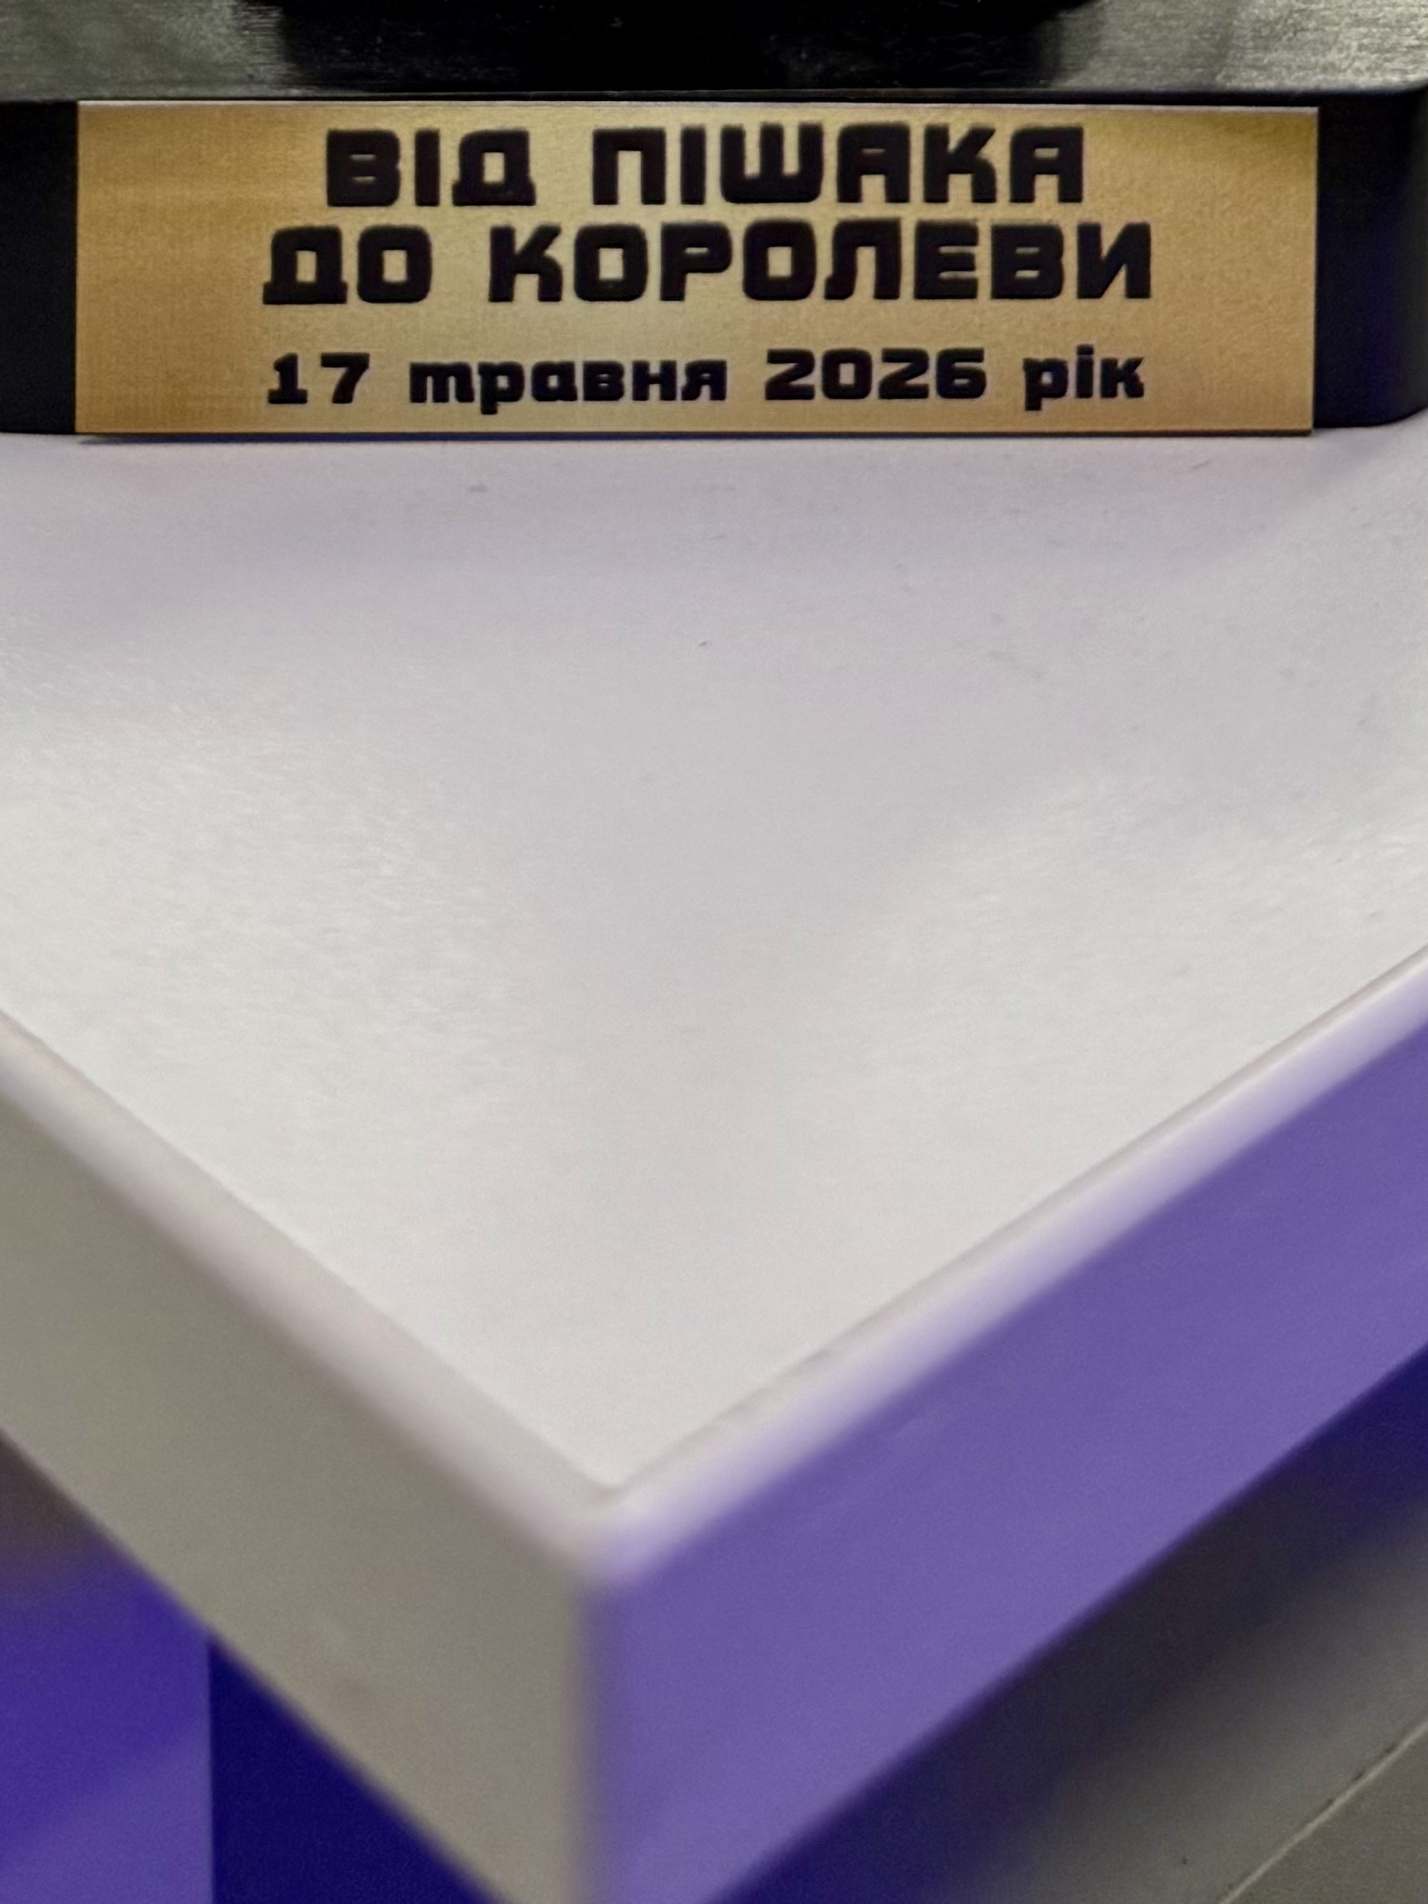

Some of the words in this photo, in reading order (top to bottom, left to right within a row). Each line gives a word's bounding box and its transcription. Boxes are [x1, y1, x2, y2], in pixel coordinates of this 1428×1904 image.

[324, 128, 538, 209] ВІД
[591, 123, 1085, 207] ПІШАКА
[261, 224, 434, 307] ДО
[487, 218, 1153, 305] КОРОЛЕВИ
[266, 351, 371, 407] 17
[408, 358, 729, 418] травня
[763, 346, 988, 402] 2026
[1021, 343, 1146, 414] рік
